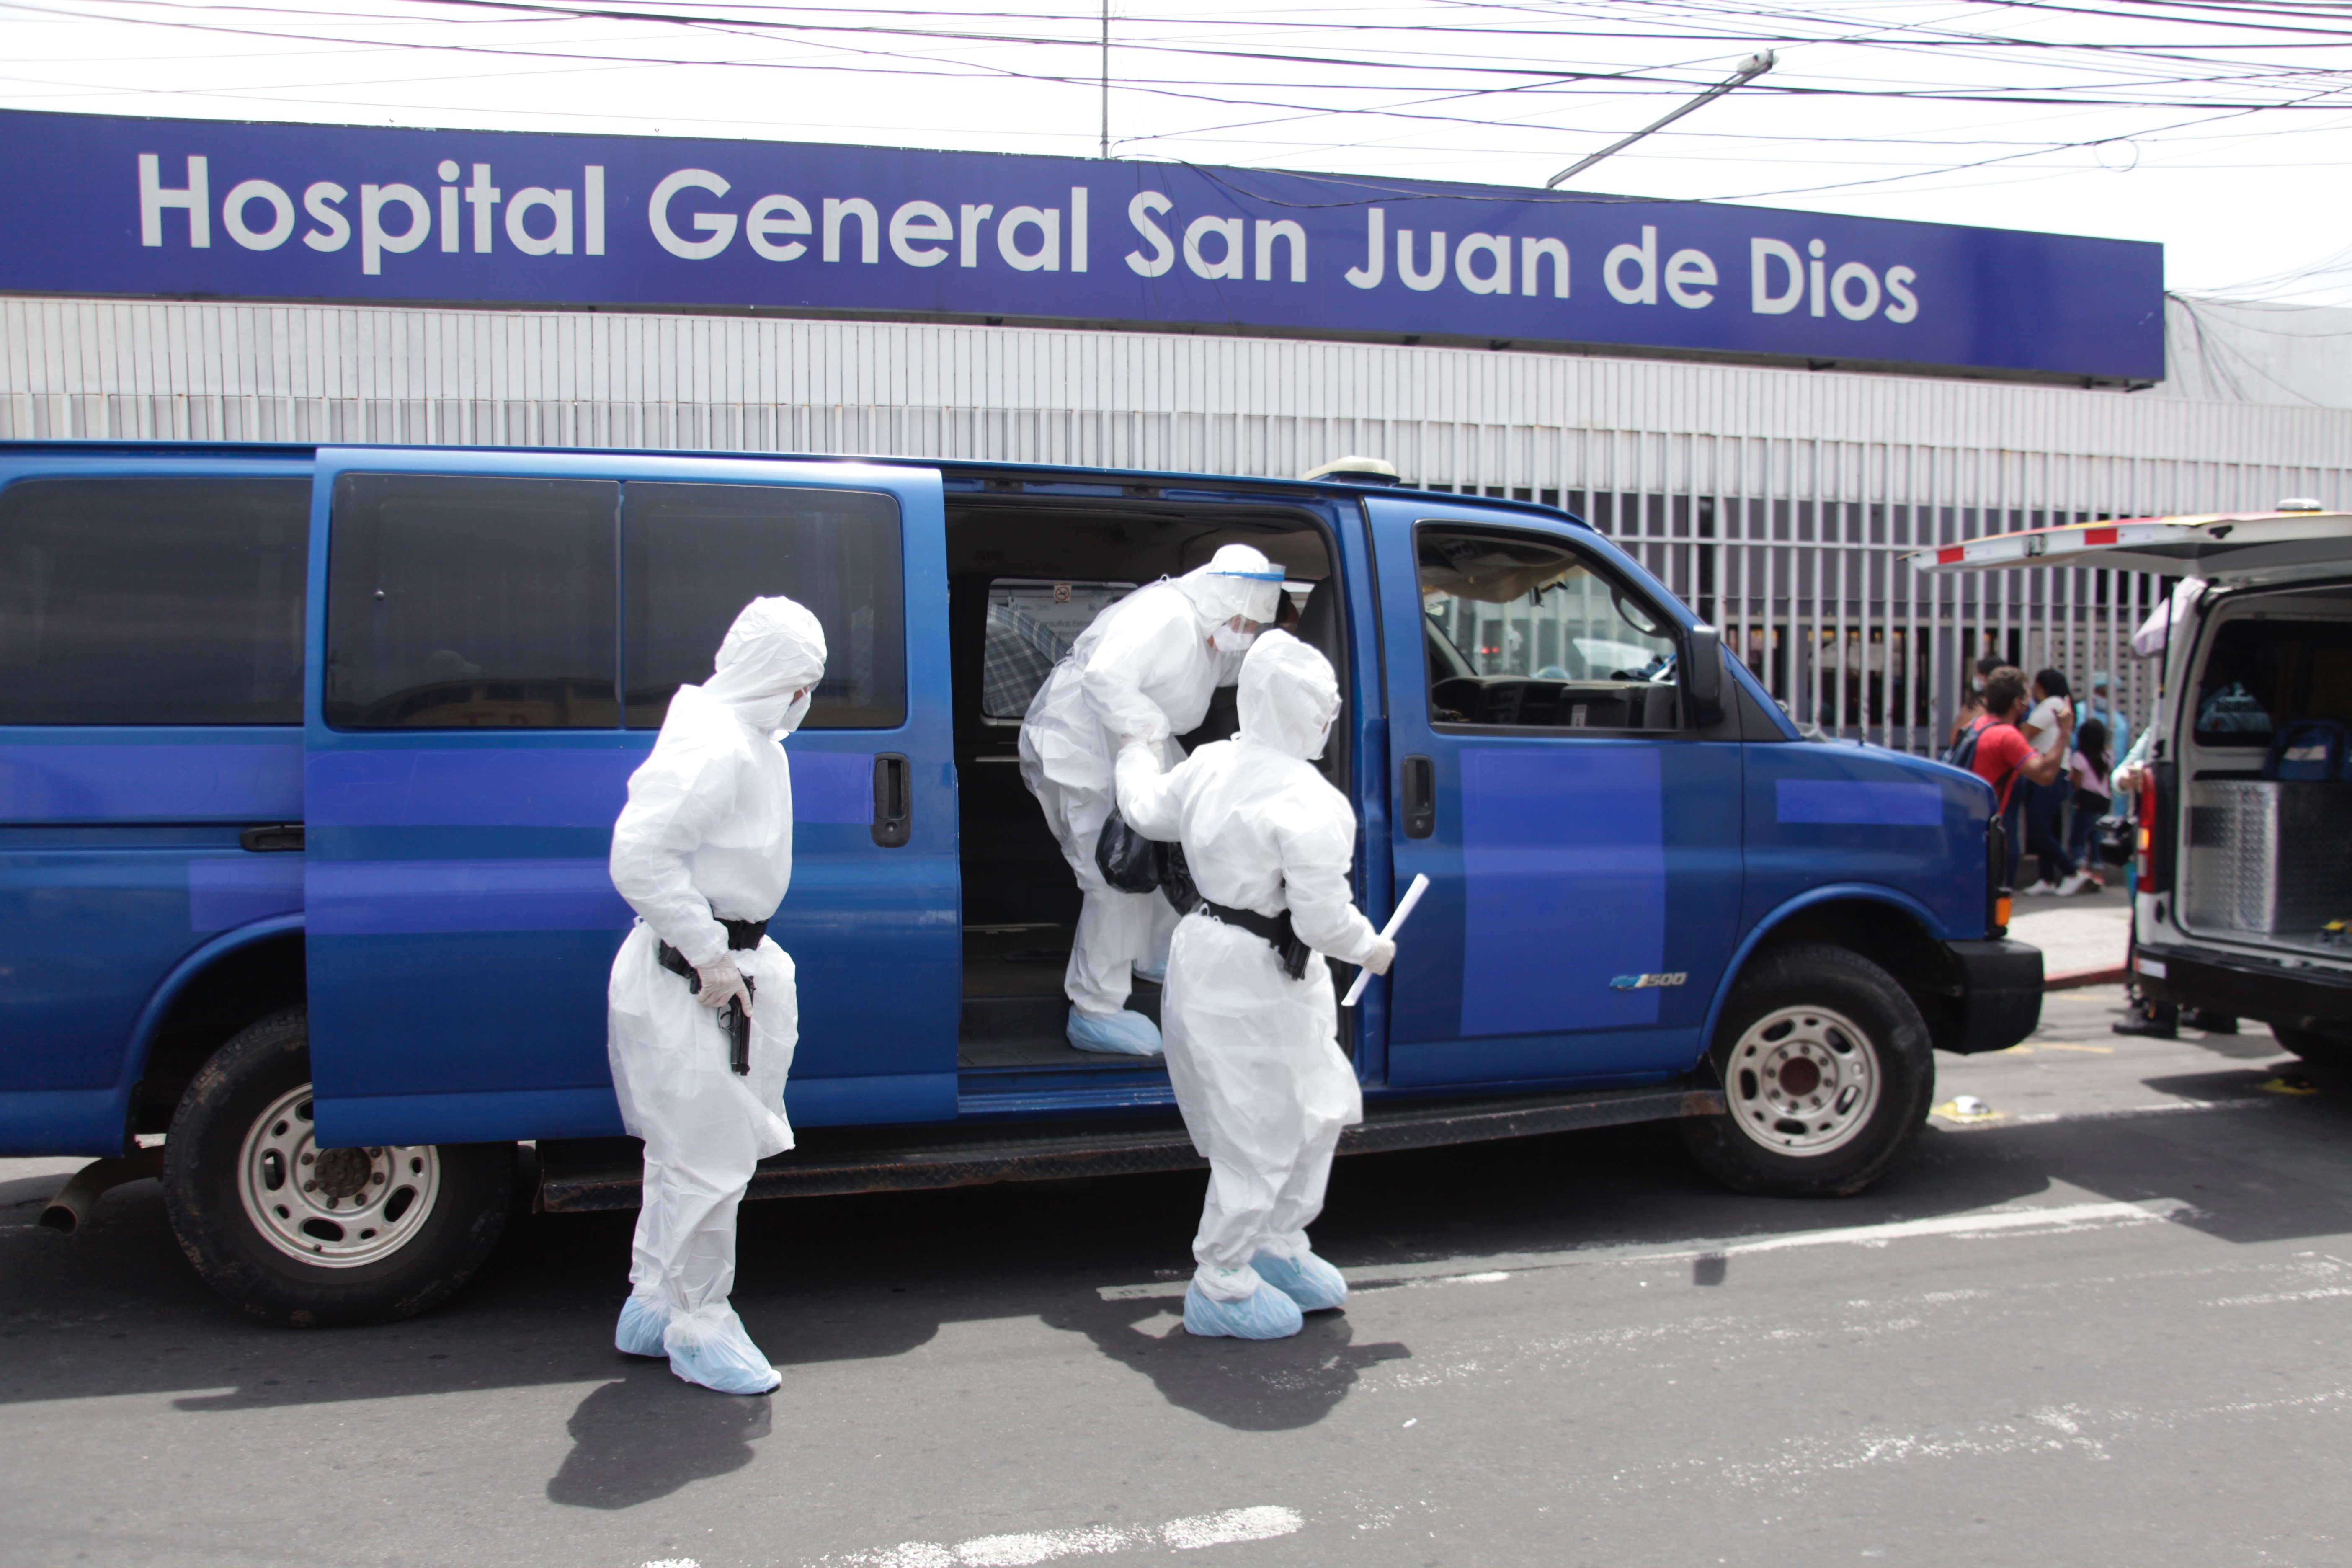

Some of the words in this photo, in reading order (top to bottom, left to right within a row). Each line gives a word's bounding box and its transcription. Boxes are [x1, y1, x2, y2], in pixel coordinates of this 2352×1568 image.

[138, 152, 605, 276] Hospital
[648, 168, 1088, 273] General
[1124, 191, 1306, 282] San
[1344, 207, 1571, 299] Juan
[1603, 226, 1719, 309] de
[1751, 237, 1919, 324] Dios
